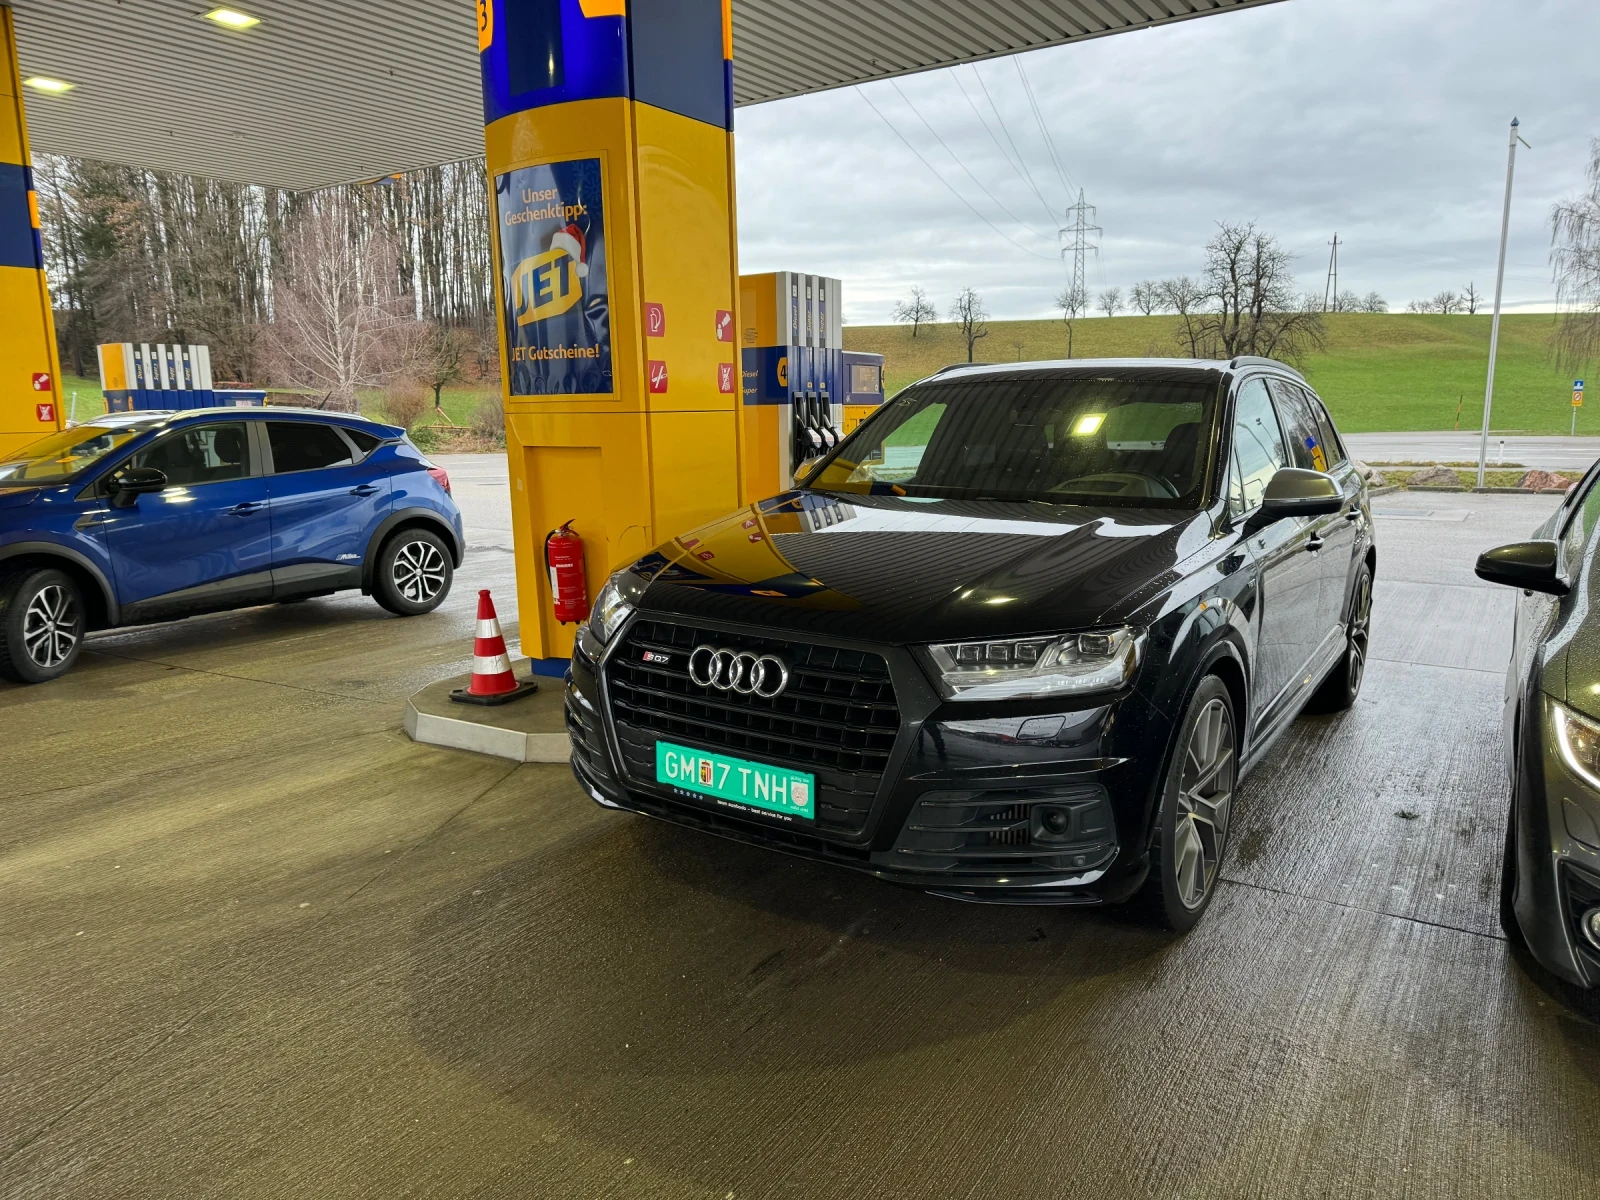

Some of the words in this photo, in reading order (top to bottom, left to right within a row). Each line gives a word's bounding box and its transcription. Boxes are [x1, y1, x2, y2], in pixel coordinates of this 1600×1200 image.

[522, 187, 558, 204] Unser
[504, 201, 588, 226] Geschenktipp:
[516, 253, 575, 316] JET
[511, 347, 526, 362] JET
[528, 344, 600, 361] Gutscheine!
[742, 370, 758, 378] Diesel
[780, 365, 788, 380] 4
[646, 652, 669, 663] SQ7
[665, 751, 695, 783] GM
[717, 763, 731, 790] 7
[738, 767, 787, 805] TNH
